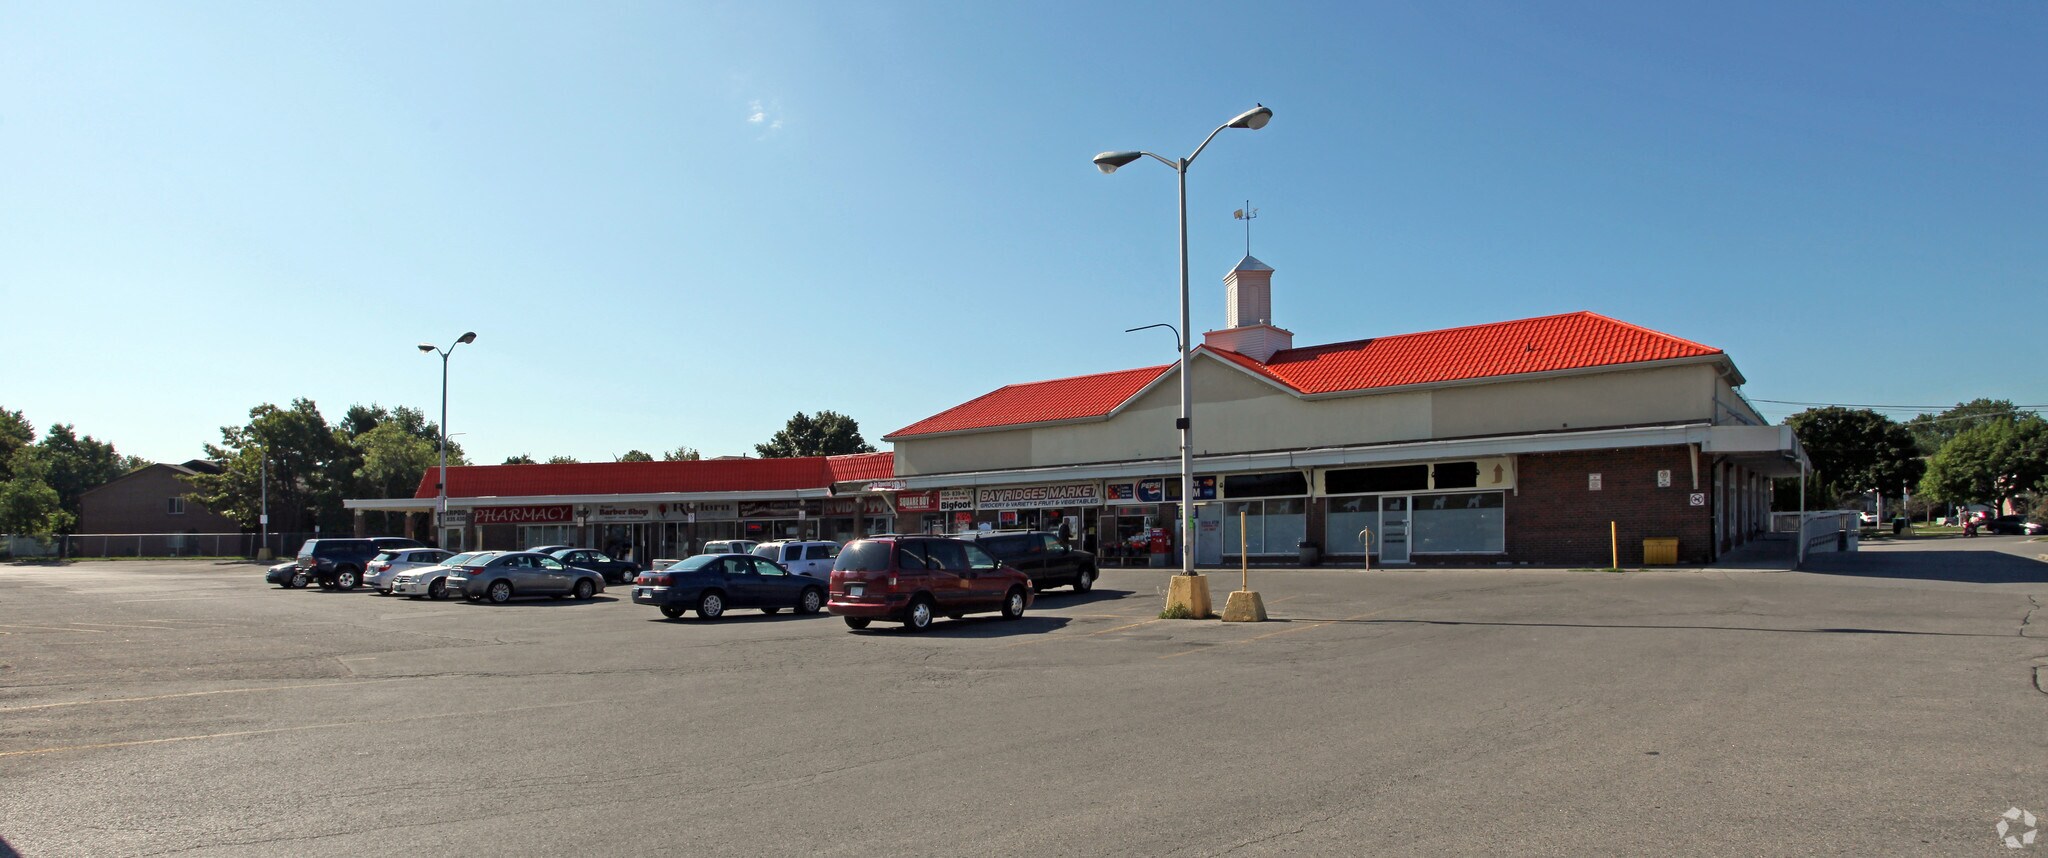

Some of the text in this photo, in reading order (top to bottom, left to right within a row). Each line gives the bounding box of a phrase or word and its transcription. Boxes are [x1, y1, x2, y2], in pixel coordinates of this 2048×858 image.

[1141, 481, 1162, 489] PEPSI
[980, 484, 1100, 502] BAY RIDGES MARKET
[899, 496, 930, 507] SQUARE BOY
[941, 501, 972, 511] Bigfoot
[474, 506, 569, 523] PHARMACY
[599, 507, 649, 517] Barber Shop
